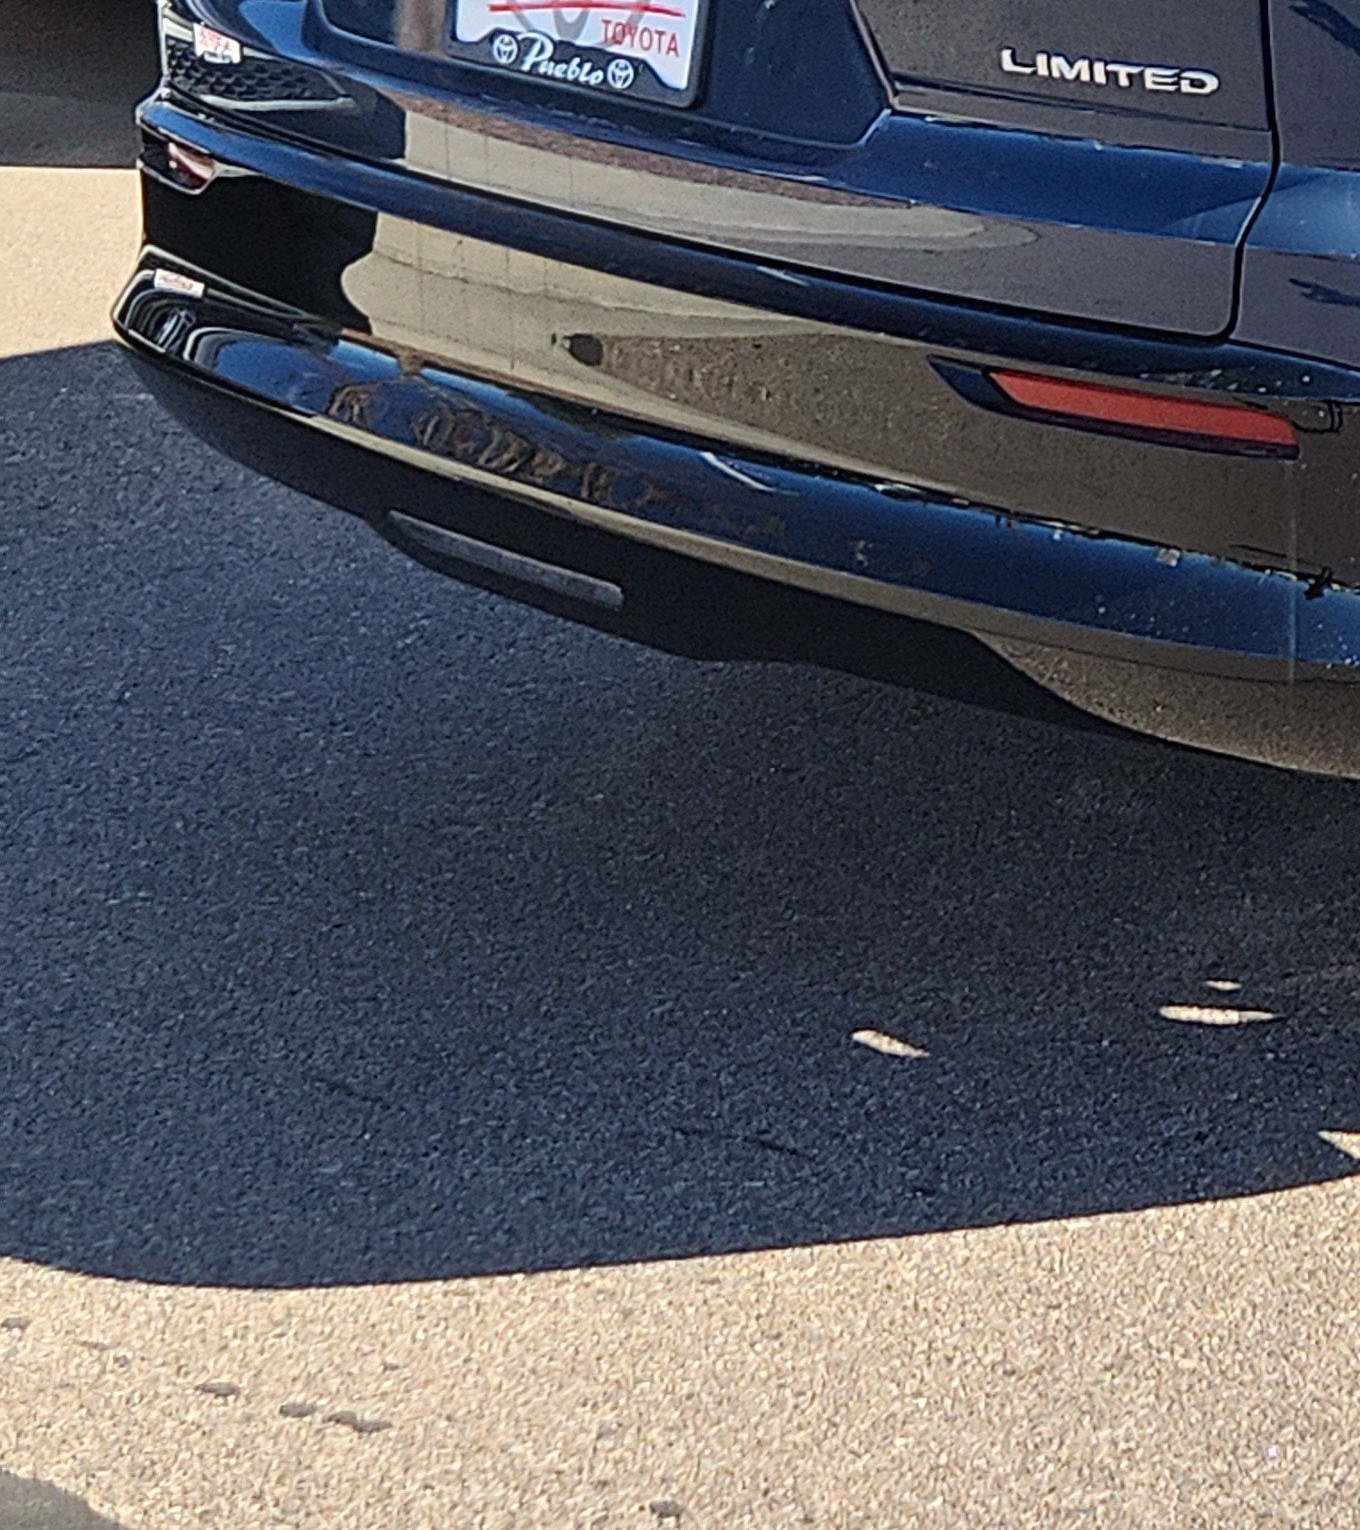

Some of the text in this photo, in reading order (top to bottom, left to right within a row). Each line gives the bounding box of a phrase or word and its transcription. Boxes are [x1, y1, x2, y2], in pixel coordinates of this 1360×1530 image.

[515, 31, 606, 88] Pueblo
[600, 19, 680, 58] TOYOTA
[1000, 46, 1220, 95] LIMITED
